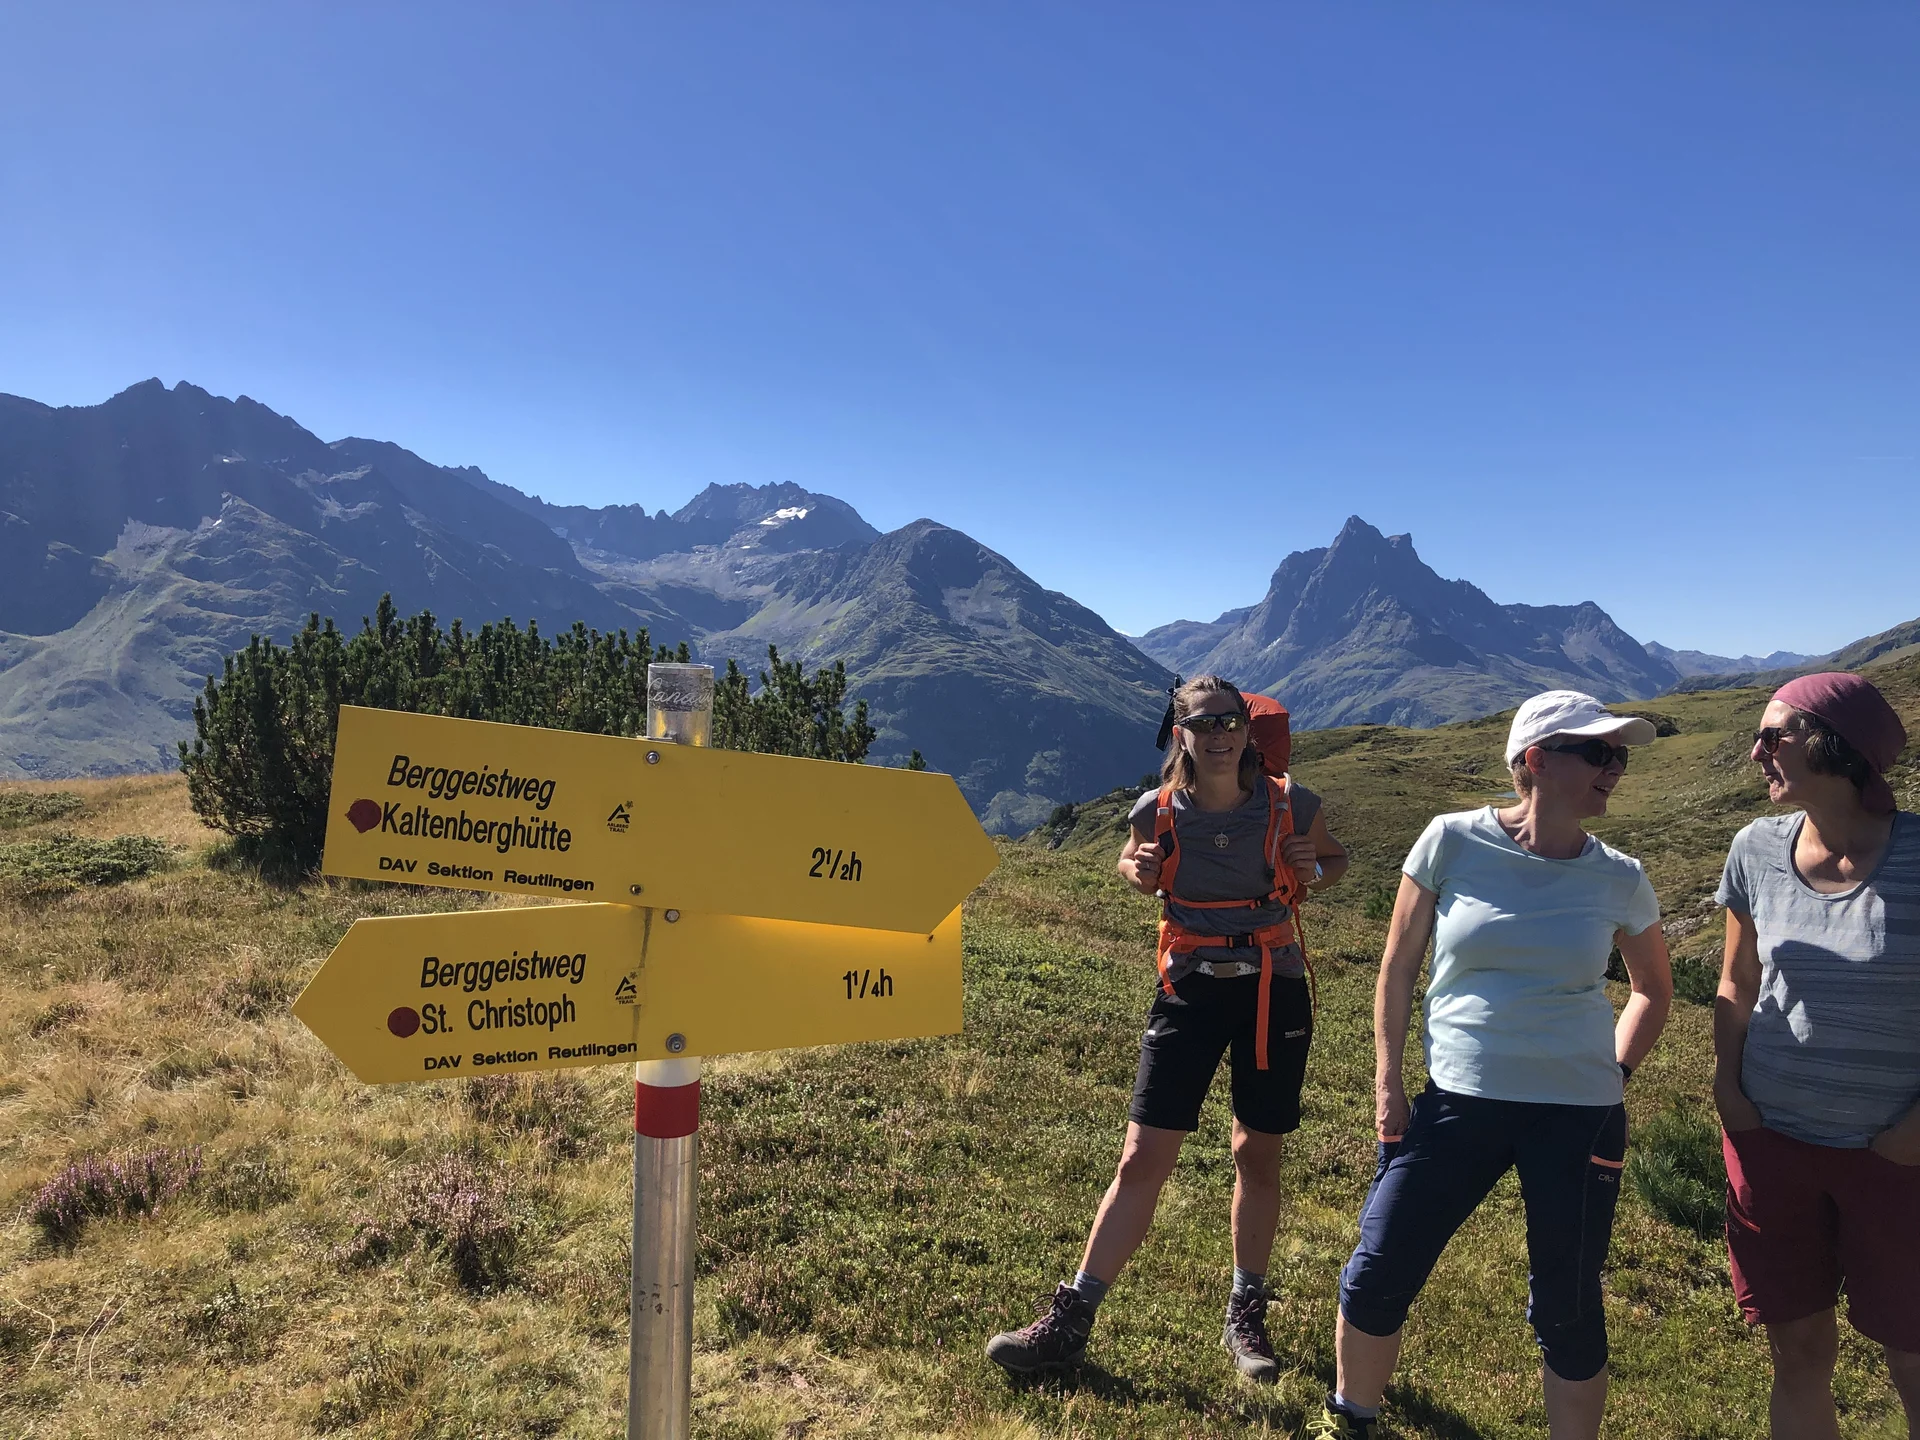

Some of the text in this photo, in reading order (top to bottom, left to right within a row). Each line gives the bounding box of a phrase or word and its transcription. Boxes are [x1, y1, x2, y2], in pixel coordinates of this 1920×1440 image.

[387, 754, 556, 811] Berggeistweg
[381, 801, 572, 853] Kaltenberghütte
[378, 856, 595, 892] DAV Sektion Reutlingen
[420, 950, 587, 993] Berggeistweg
[421, 993, 576, 1035] St. Christoph
[424, 1042, 638, 1071] DAV Sektion Reutlingen
